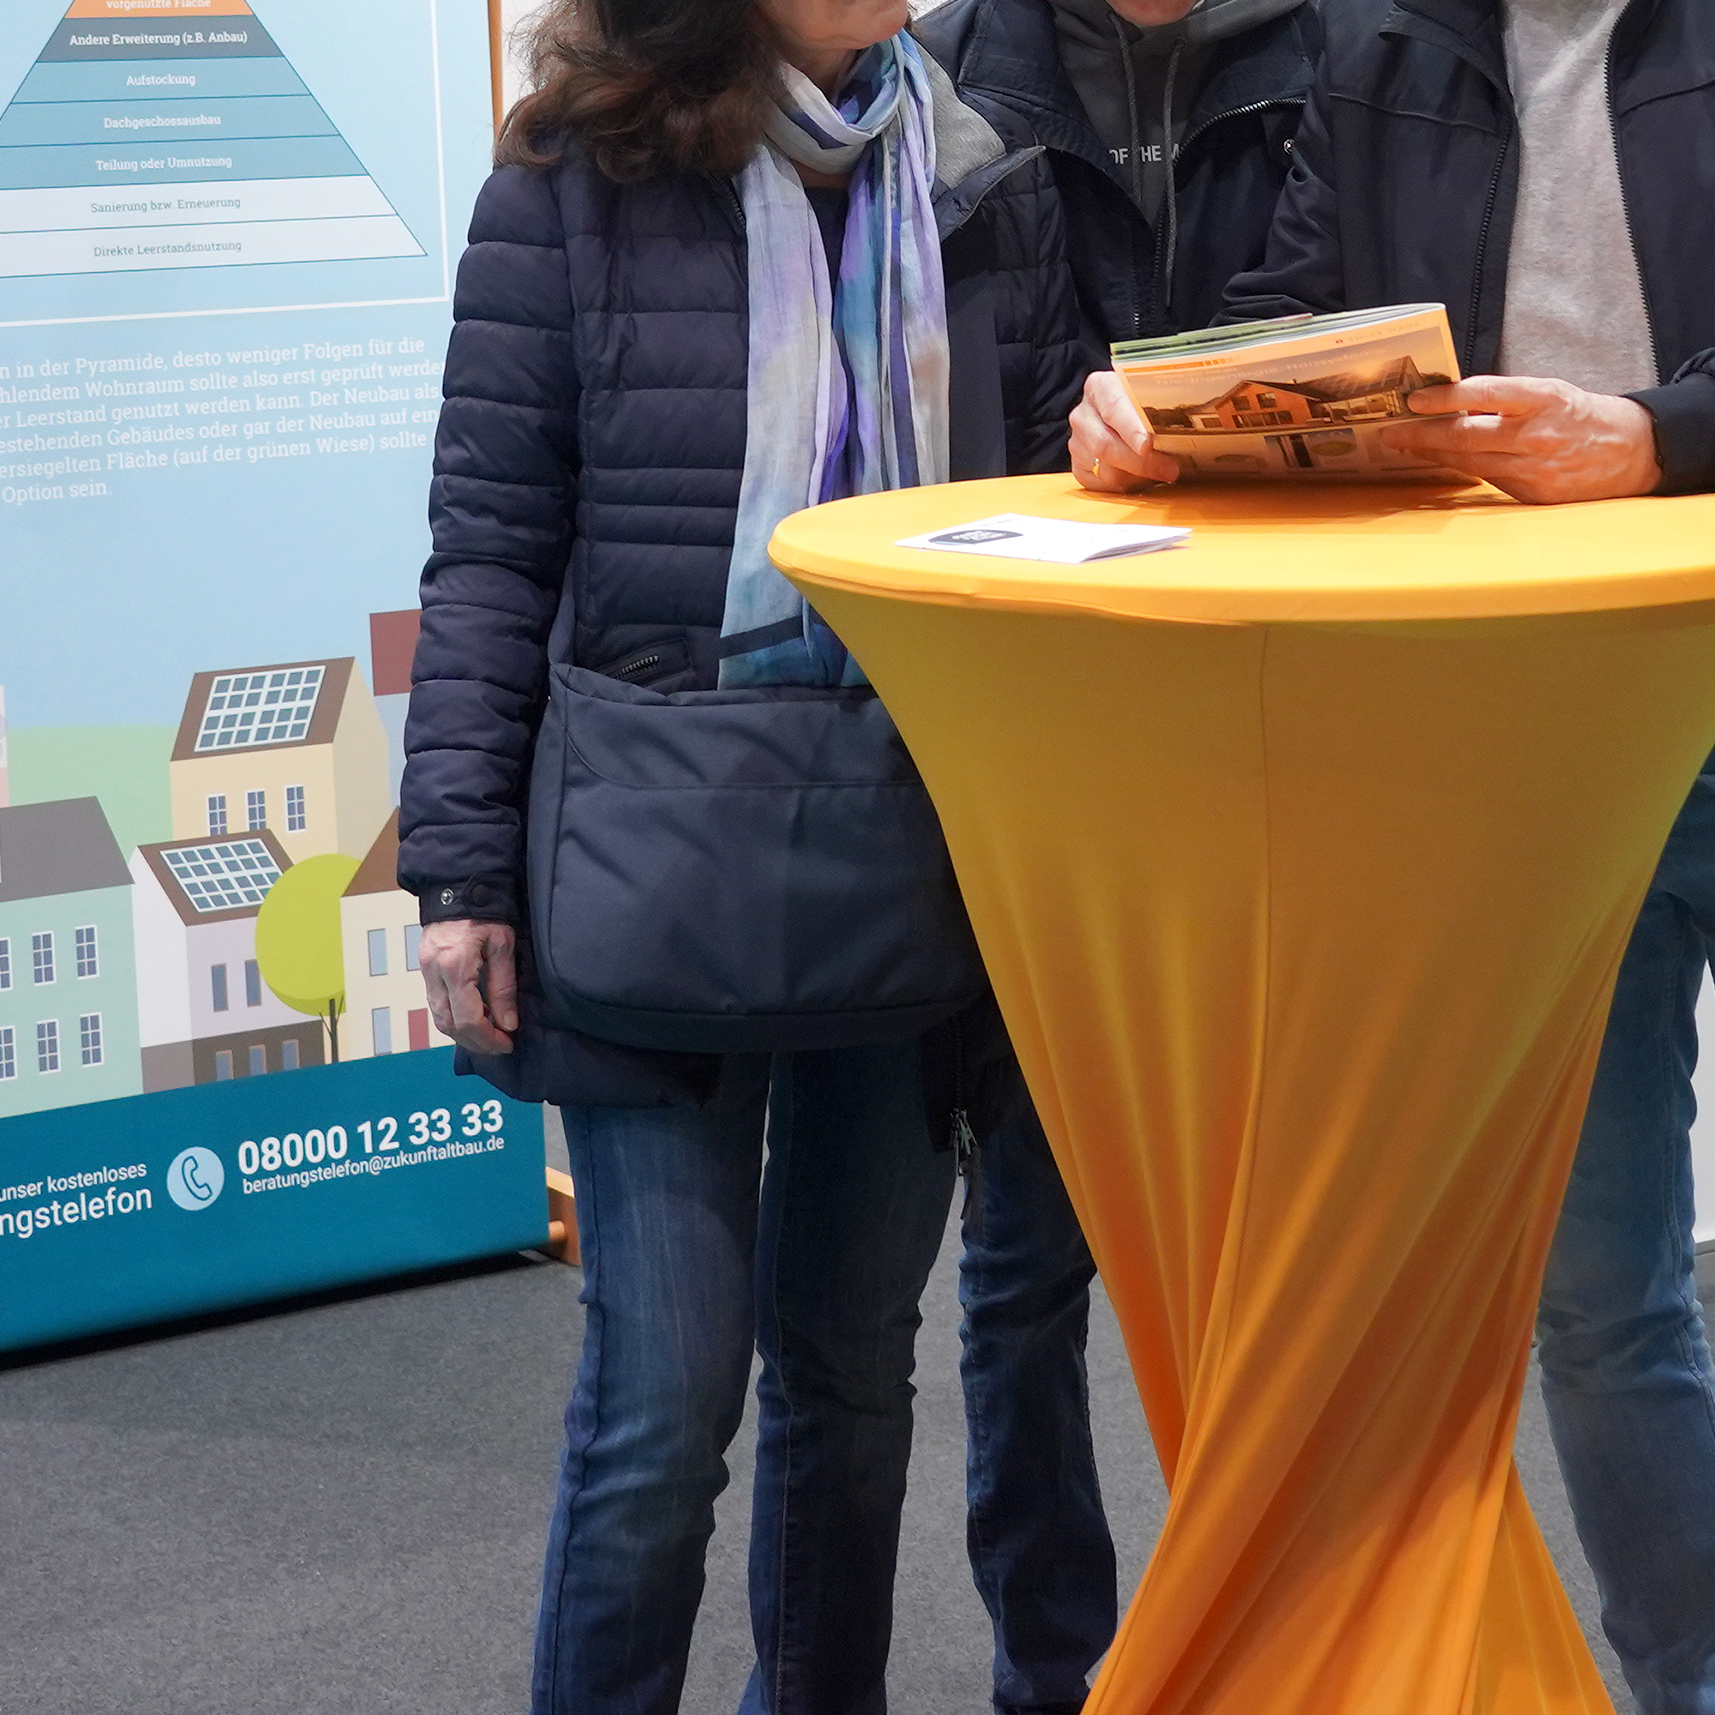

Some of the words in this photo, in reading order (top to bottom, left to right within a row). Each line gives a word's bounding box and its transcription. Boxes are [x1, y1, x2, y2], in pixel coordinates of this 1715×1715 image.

[106, 0, 172, 11] vorgenutzte
[70, 34, 110, 46] Andere
[112, 34, 180, 46] Erweiterung
[182, 32, 206, 45] (z.B.
[208, 31, 248, 44] Anbau)
[126, 74, 196, 86] Aufstockung
[104, 115, 222, 129] Dachgeschossausbau
[95, 159, 138, 172] Teilung
[140, 158, 165, 169] oder
[167, 157, 232, 168] Umnutzung
[90, 202, 148, 213] Sanierung
[177, 199, 241, 209] Erneuerung
[94, 246, 134, 257] Direkte
[137, 242, 242, 255] Leerstandsnutzung
[16, 361, 35, 378] in
[40, 359, 70, 376] der
[75, 353, 168, 376] Pyramide,
[172, 351, 222, 368] desto
[226, 346, 299, 365] weniger
[303, 342, 363, 361] Folgen
[368, 338, 394, 355] für
[398, 336, 425, 354] die
[84, 380, 185, 397] Wohnraum
[190, 372, 238, 391] sollte
[242, 370, 278, 387] also
[282, 368, 316, 385] erst
[320, 362, 384, 386] geprüft
[16, 405, 107, 428] Leerstand
[111, 402, 180, 424] genutzt
[184, 396, 251, 414] werden
[309, 391, 340, 407] Der
[343, 386, 410, 404] Neubau
[414, 382, 440, 400] als
[107, 424, 194, 445] Gebäudes
[198, 421, 238, 438] oder
[242, 422, 271, 439] gar
[276, 416, 305, 433] der
[308, 412, 376, 430] Neubau
[380, 408, 408, 426] auf
[106, 451, 168, 470] Fläche
[173, 446, 208, 468] (auf
[213, 446, 242, 462] der
[247, 442, 311, 463] grünen
[315, 435, 375, 453] Wiese)
[379, 432, 428, 449] sollte
[2, 484, 64, 506] Option
[68, 480, 112, 498] sein.
[238, 1126, 348, 1173] 08000
[357, 1117, 400, 1153] 12
[408, 1108, 452, 1145] 33
[461, 1100, 504, 1136] 33
[47, 1164, 147, 1192] kostenloses
[242, 1137, 504, 1193] beratungstelefon@zukunftaltbau.de
